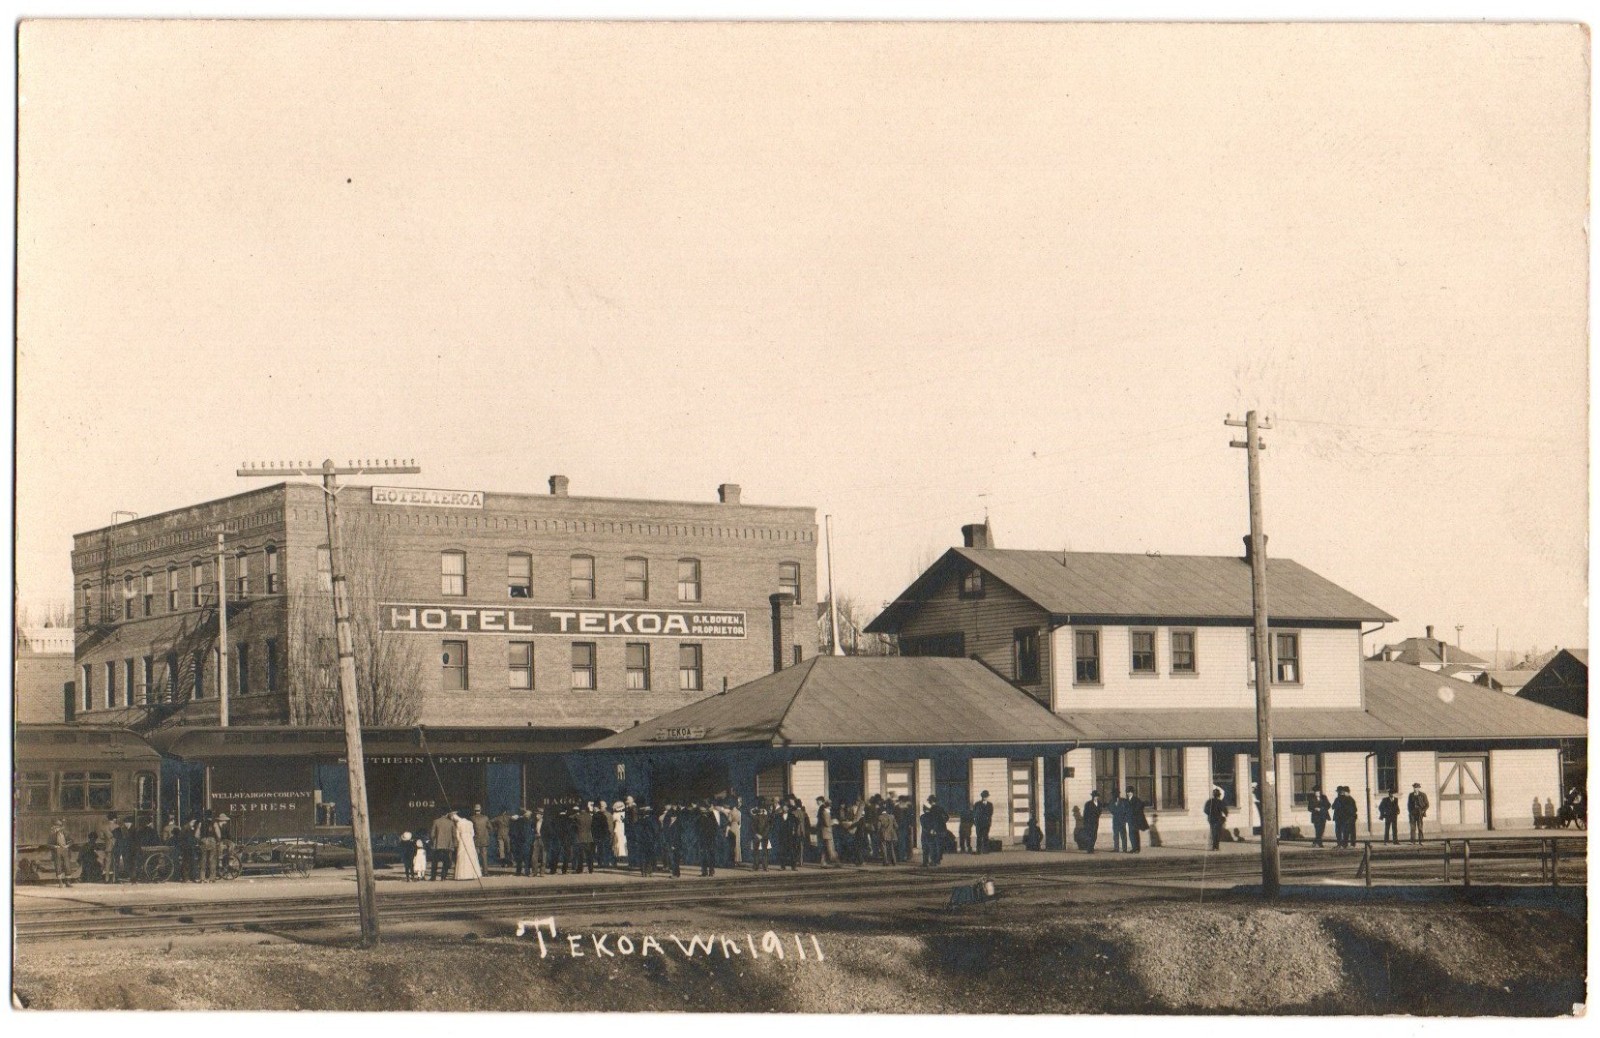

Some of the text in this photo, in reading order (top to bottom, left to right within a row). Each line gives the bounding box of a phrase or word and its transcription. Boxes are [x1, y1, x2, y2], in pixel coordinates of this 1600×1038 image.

[375, 489, 482, 506] HOTEL TEKOA
[391, 608, 689, 634] HOTEL TEKOA
[691, 625, 744, 635] PROPRIETOR
[667, 728, 691, 737] TEKOA
[229, 802, 296, 812] EXPRESS
[408, 800, 436, 808] 6002
